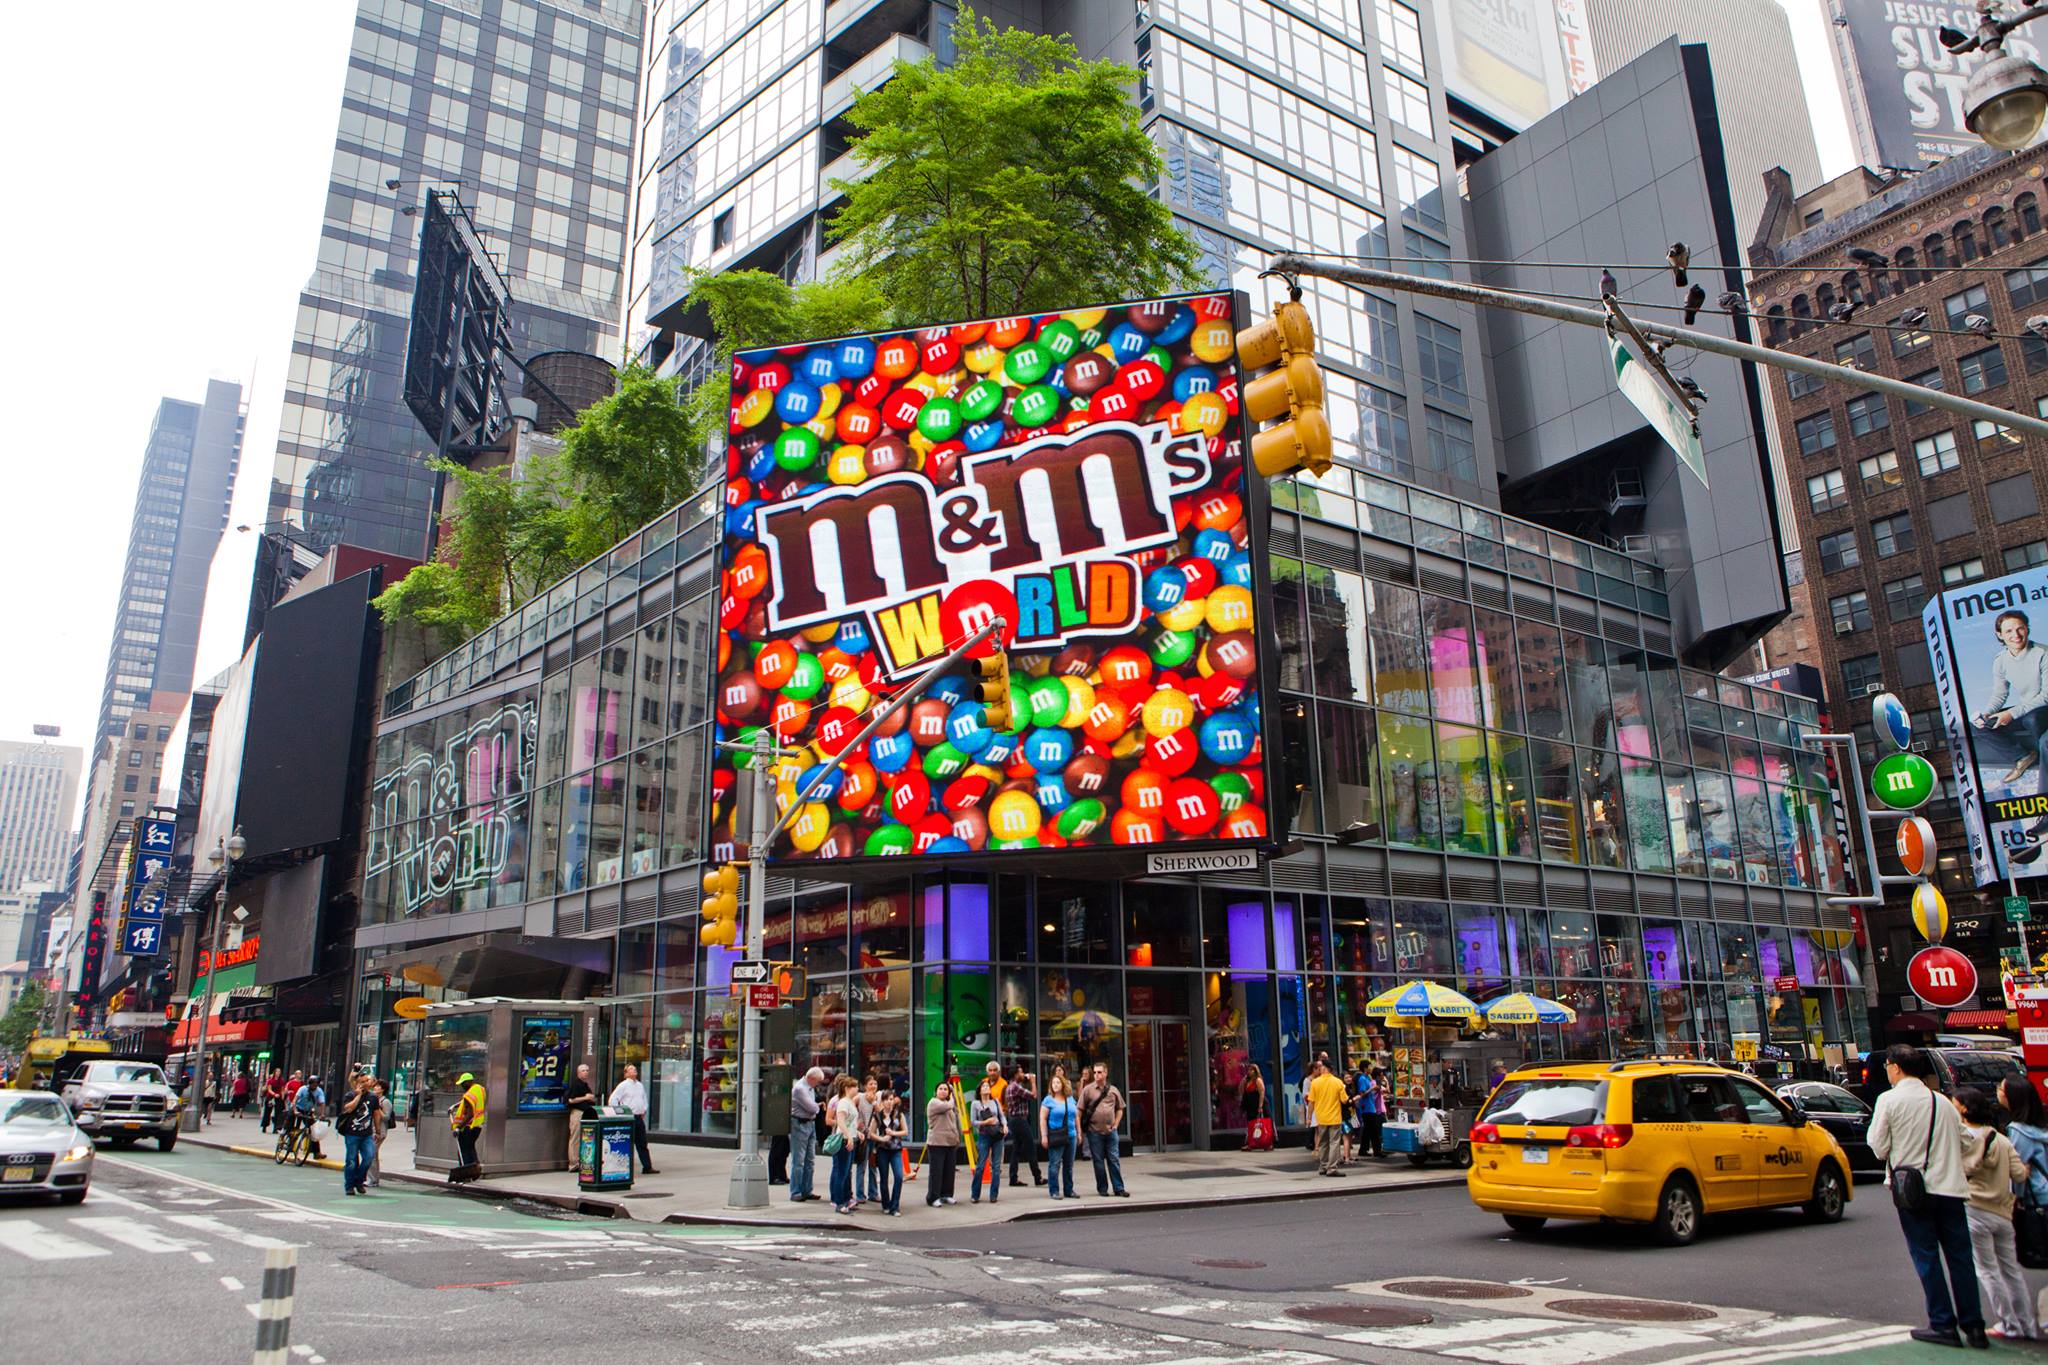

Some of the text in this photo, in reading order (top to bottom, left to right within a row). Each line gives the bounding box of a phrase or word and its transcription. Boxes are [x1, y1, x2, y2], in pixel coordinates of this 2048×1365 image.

[1884, 1, 1950, 27] JESUS
[1952, 582, 2048, 621] men at
[1928, 616, 1950, 697] men
[1887, 769, 1914, 791] m
[1995, 796, 2048, 818] THUR
[2001, 829, 2040, 847] tbs
[1153, 855, 1250, 871] SHERWOOD
[736, 967, 763, 977] ONE WAY
[1929, 966, 1957, 987] m
[1434, 1006, 1472, 1014] SABRETT
[535, 1055, 558, 1076] 22
